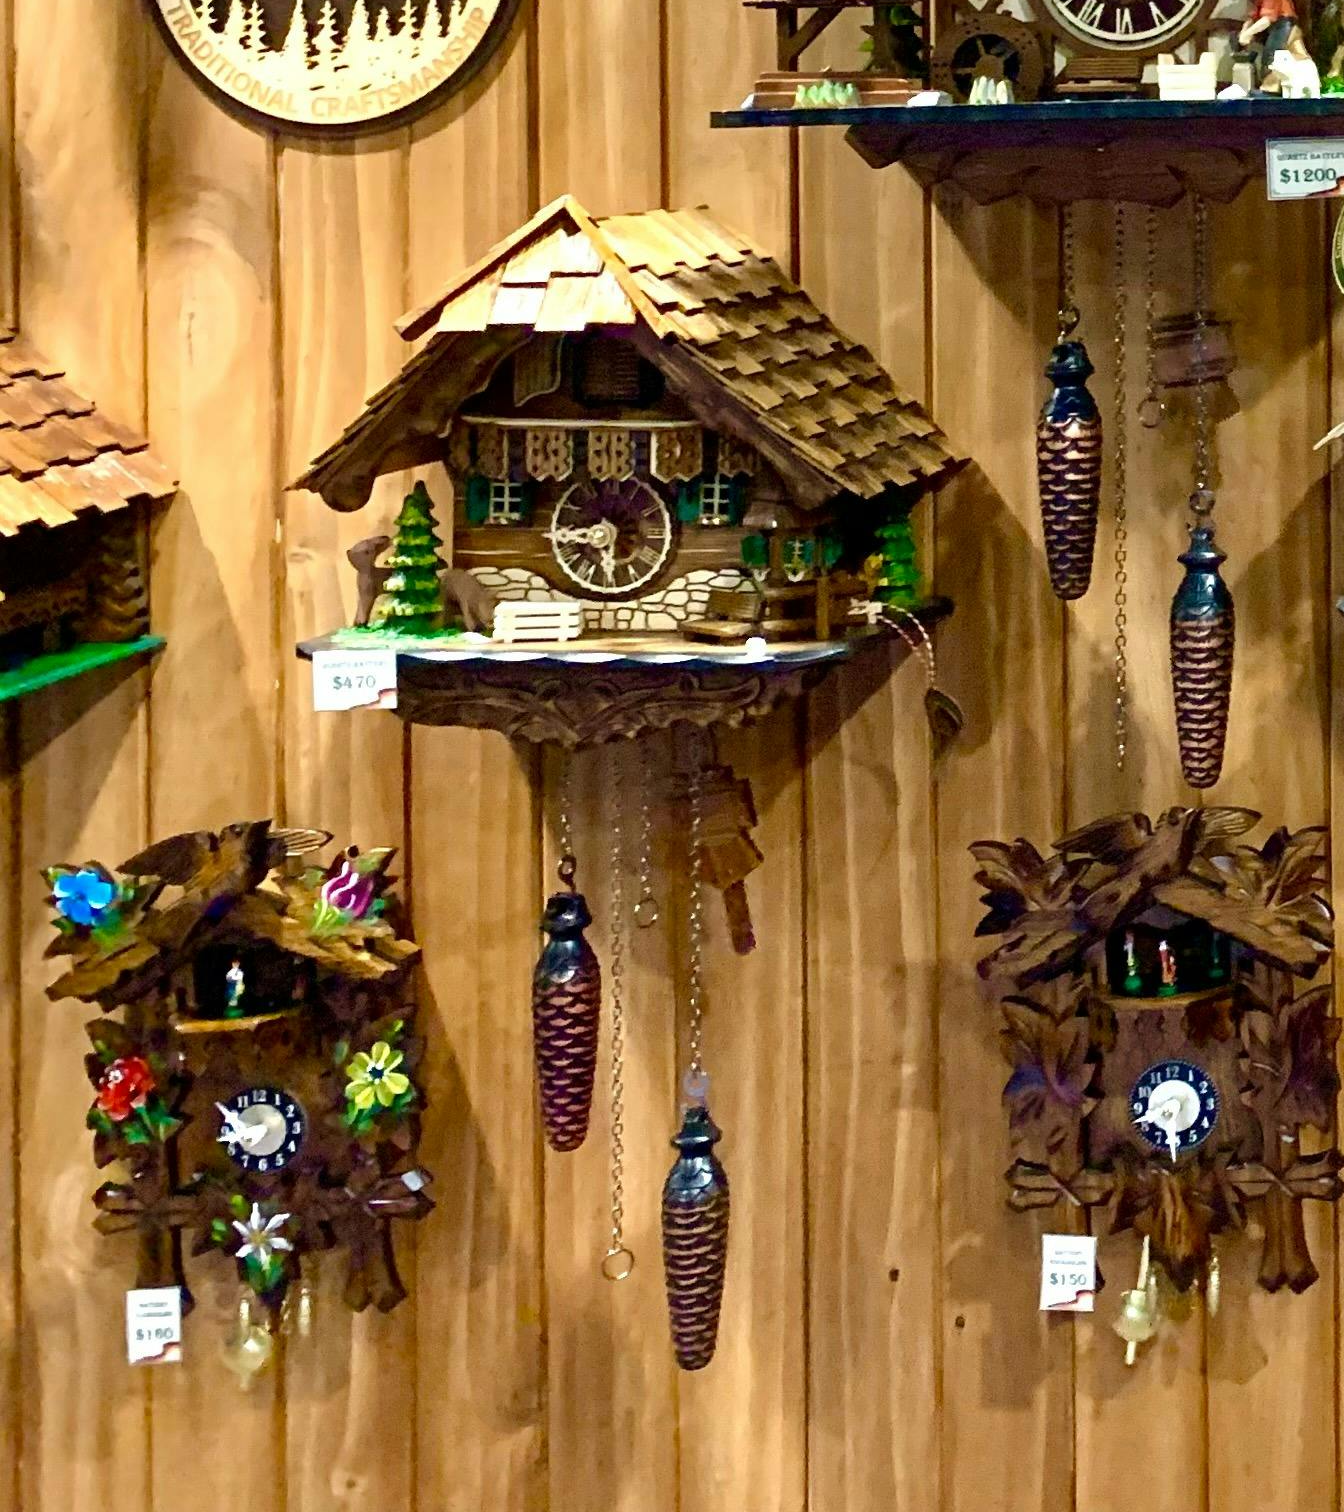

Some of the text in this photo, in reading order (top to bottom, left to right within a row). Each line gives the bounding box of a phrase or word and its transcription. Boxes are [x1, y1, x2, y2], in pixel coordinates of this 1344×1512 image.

[166, 0, 489, 118] TRADITIONAL CRAFTSMANSHIP
[1280, 168, 1337, 184] $1200
[333, 675, 376, 690] $470
[1050, 1272, 1087, 1285] $150
